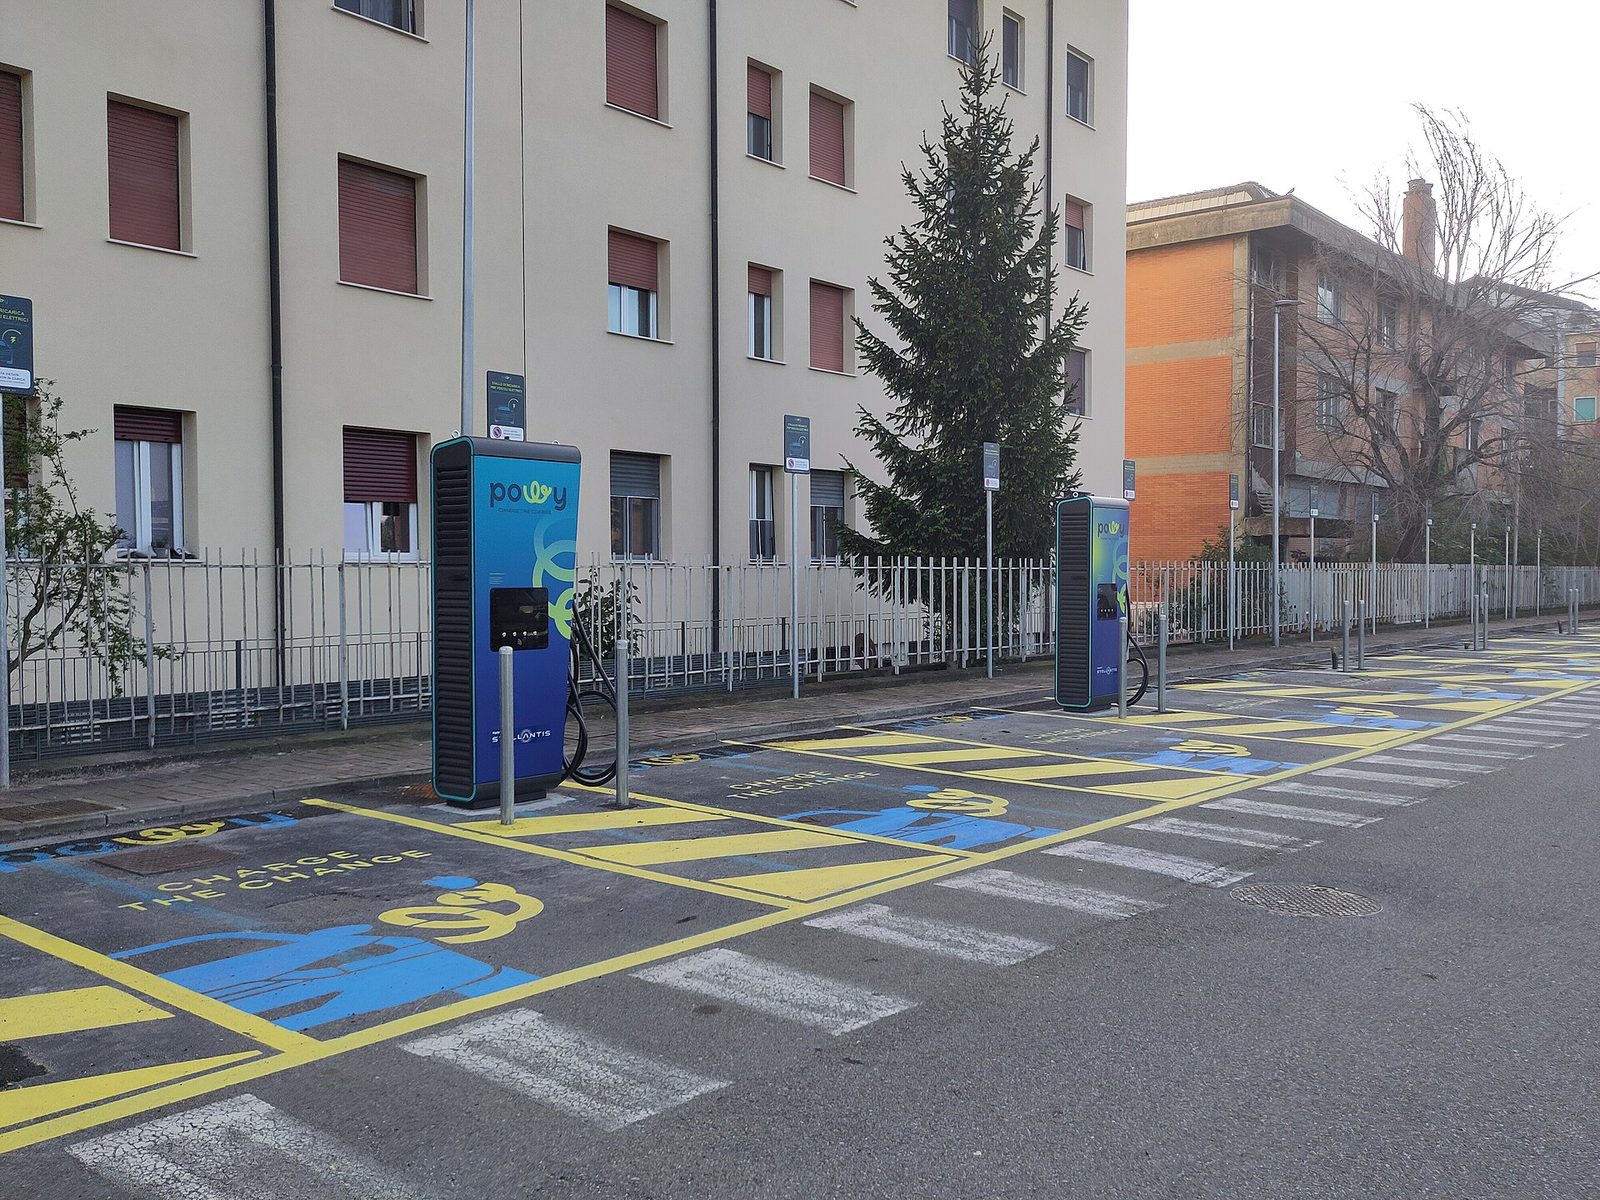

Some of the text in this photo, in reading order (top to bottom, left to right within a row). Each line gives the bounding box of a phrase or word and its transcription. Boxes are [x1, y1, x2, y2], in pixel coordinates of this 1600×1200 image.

[490, 480, 567, 511] powy
[118, 849, 433, 911] THE CHANGE
[157, 850, 359, 892] CHARGE
